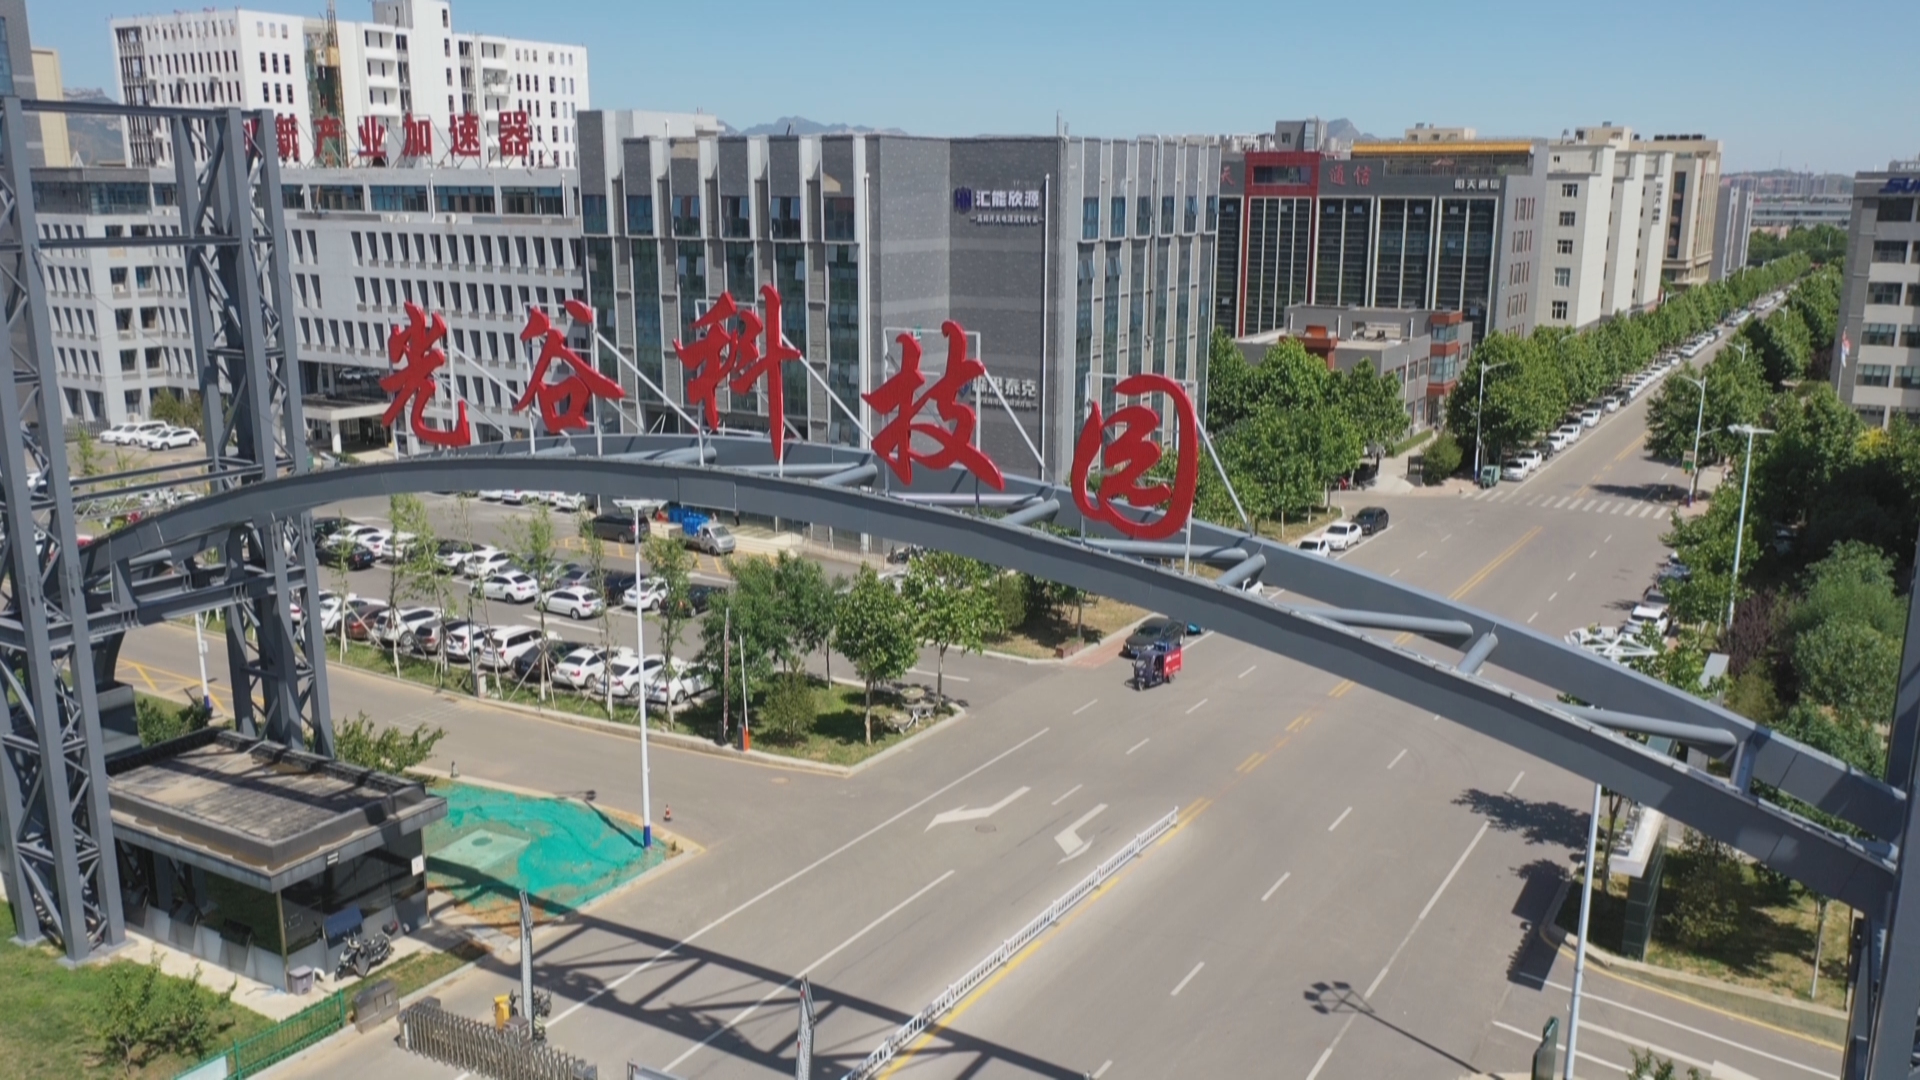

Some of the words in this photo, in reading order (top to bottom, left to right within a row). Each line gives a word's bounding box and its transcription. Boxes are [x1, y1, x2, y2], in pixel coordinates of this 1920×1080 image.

[1329, 163, 1373, 188] 通信
[975, 189, 1040, 209] 汇能欣源
[379, 285, 1199, 539] 光谷科技园
